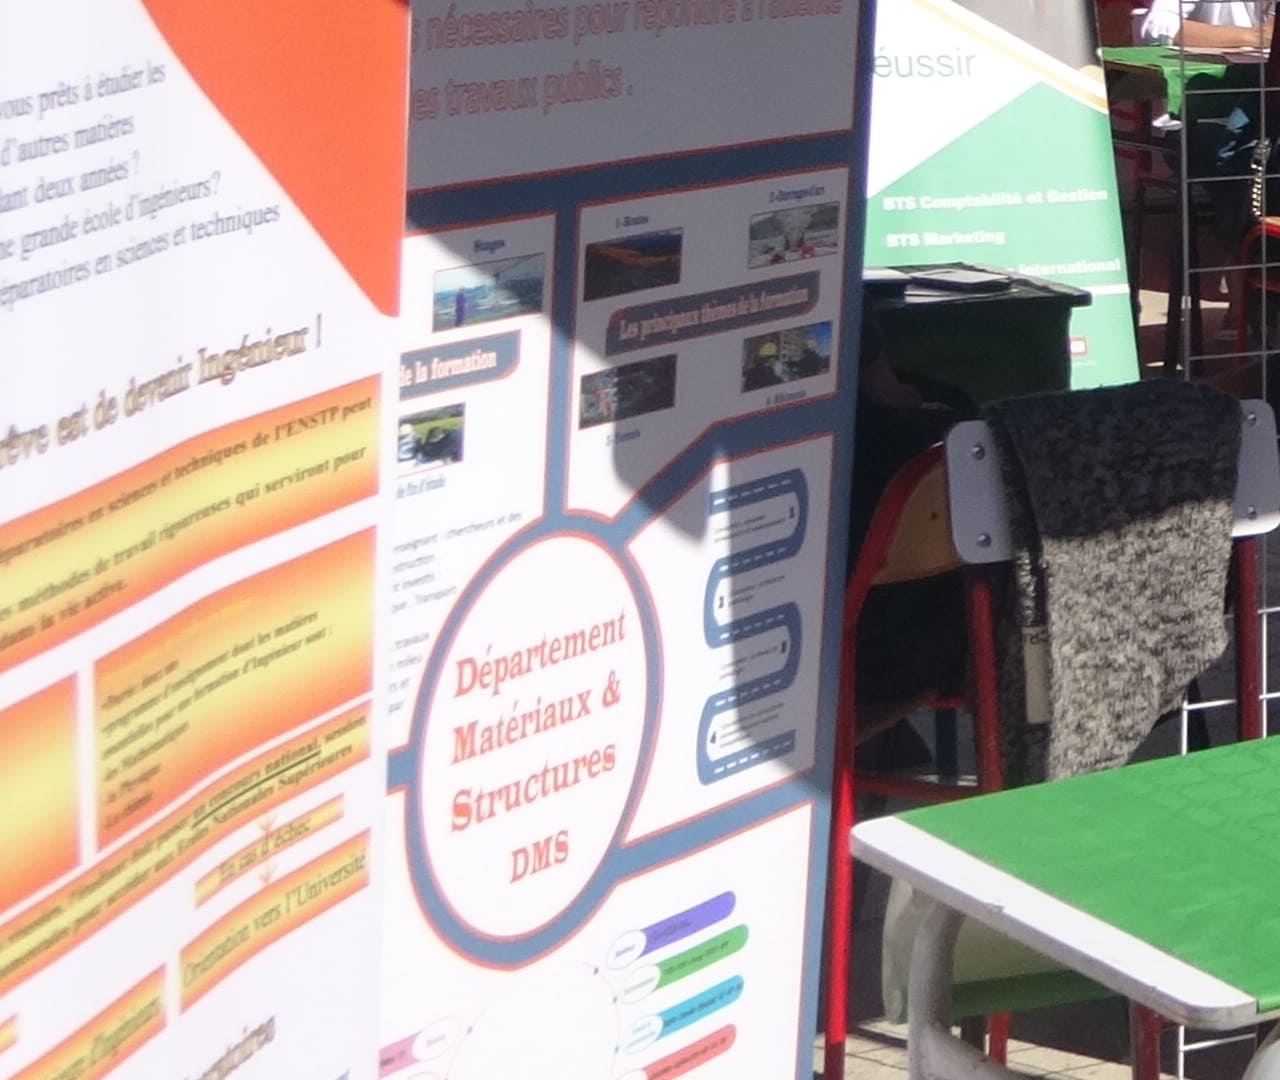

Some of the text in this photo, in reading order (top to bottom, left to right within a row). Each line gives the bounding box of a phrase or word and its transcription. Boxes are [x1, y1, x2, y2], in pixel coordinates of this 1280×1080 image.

[872, 46, 976, 78] éussir
[883, 196, 916, 210] BTS
[1026, 191, 1043, 204] et
[1047, 189, 1108, 203] Gestion
[886, 234, 920, 247] BTS
[0, 423, 50, 469] êve
[56, 405, 89, 446] est
[94, 389, 119, 436] de
[124, 354, 192, 416] devenir
[198, 328, 308, 385] Ingénieur
[455, 611, 626, 698] Département
[453, 670, 621, 765] Matériaux &
[451, 743, 616, 833] Structures
[509, 829, 569, 884] DMS
